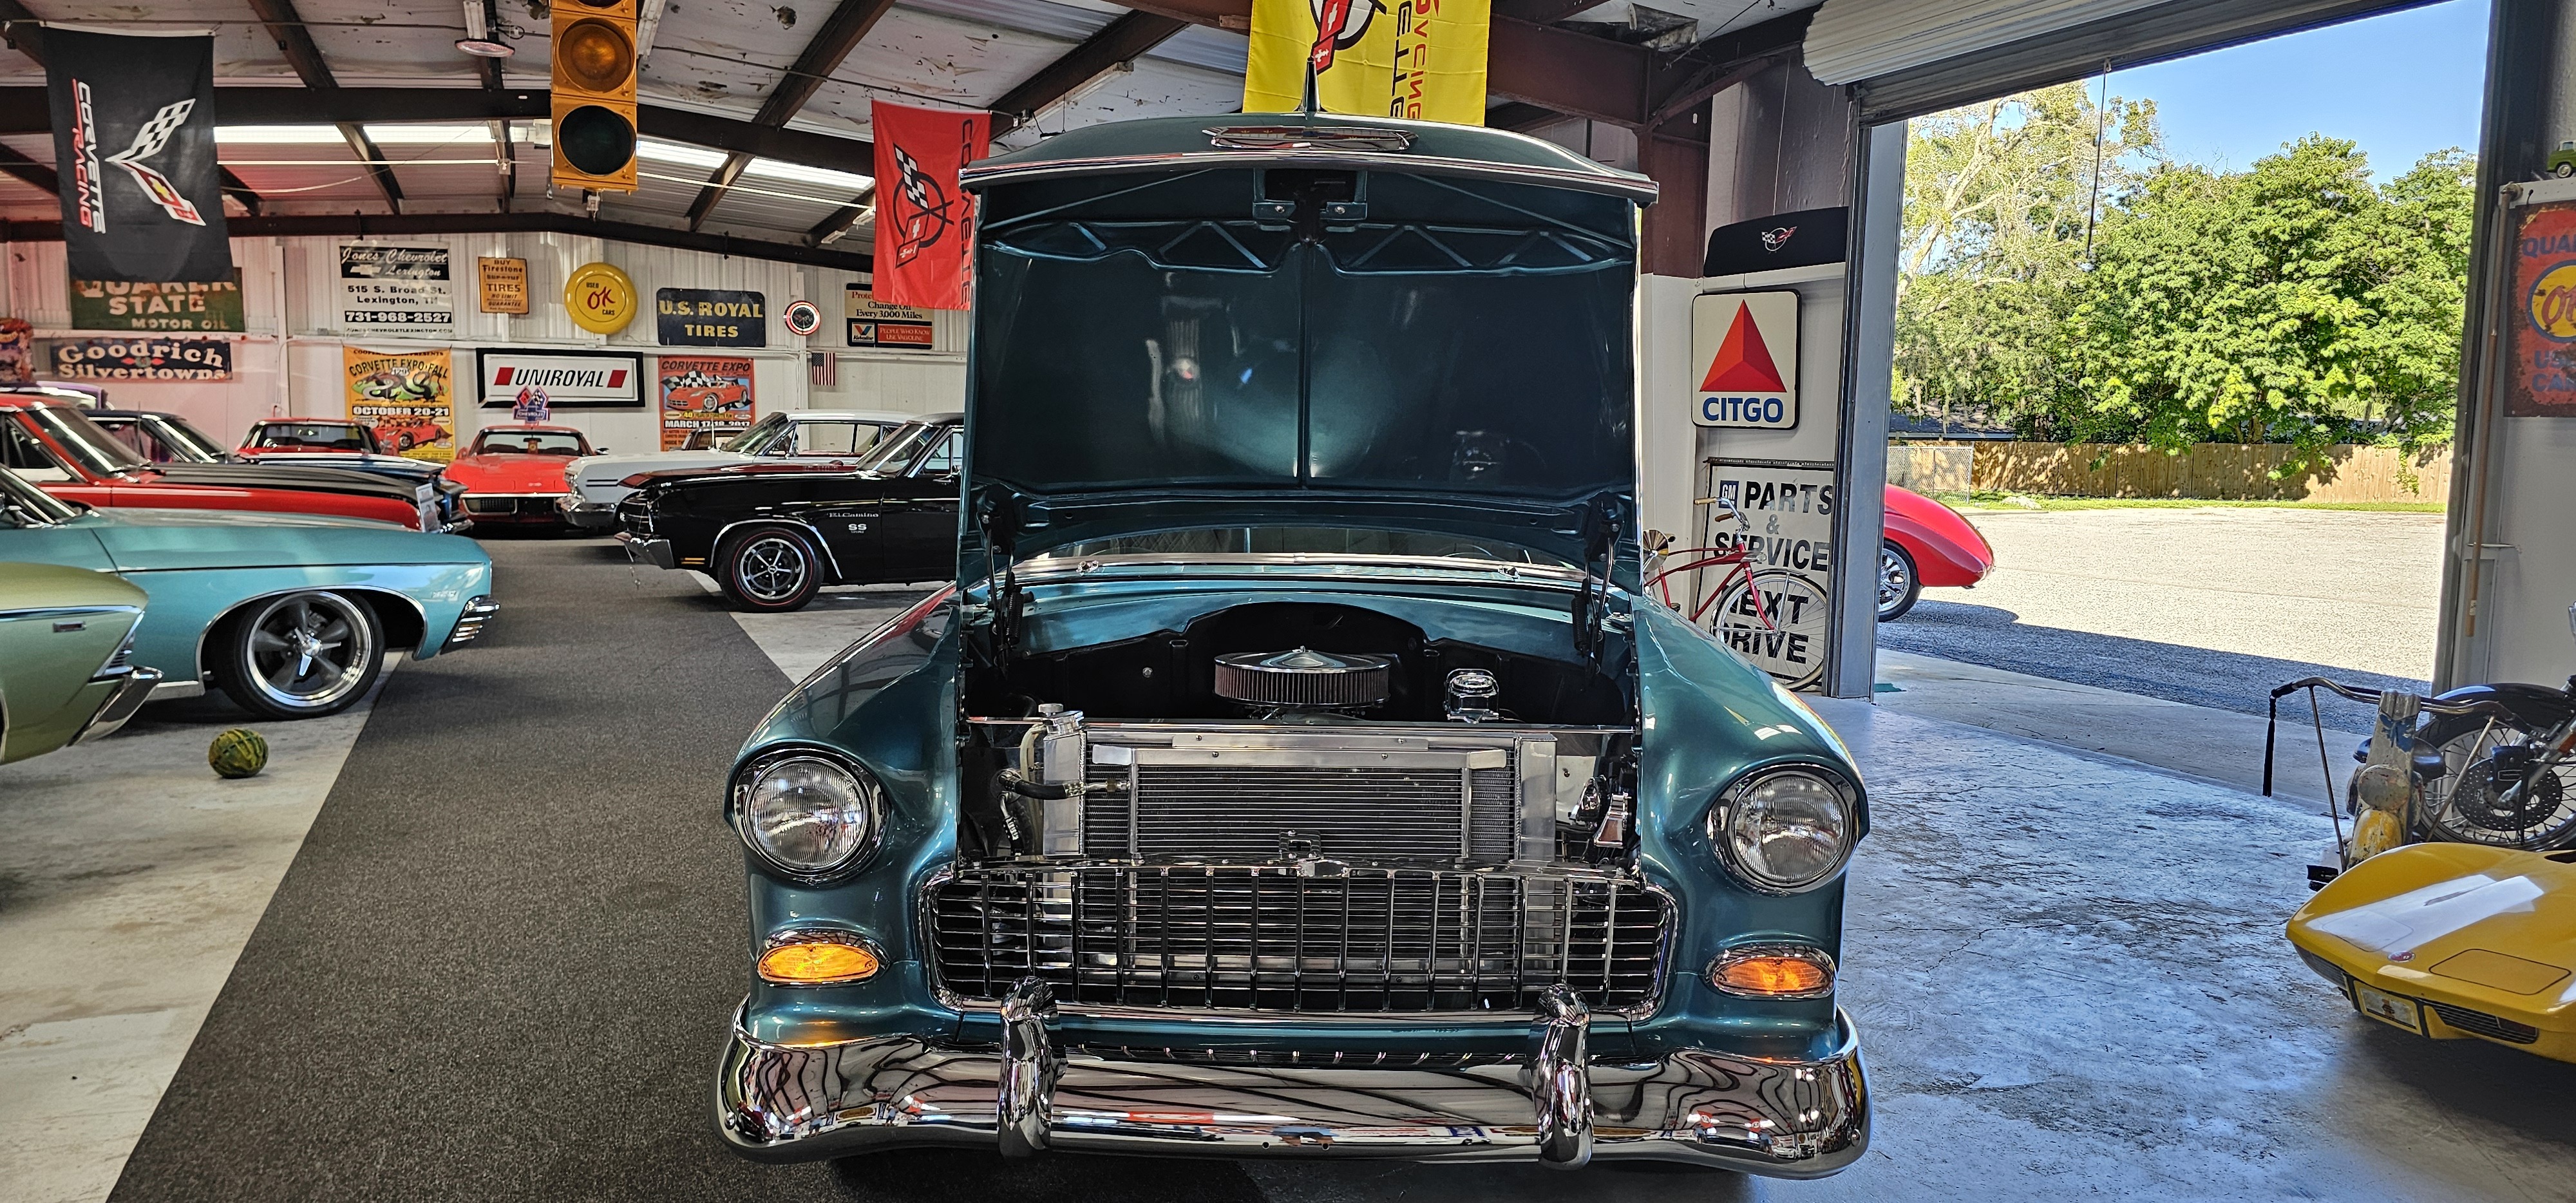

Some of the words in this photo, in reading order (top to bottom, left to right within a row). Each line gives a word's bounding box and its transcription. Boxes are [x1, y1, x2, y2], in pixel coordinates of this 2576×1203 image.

[72, 78, 92, 227] RACING
[78, 81, 106, 234] CORVETTE
[2522, 234, 2576, 258] QUA
[341, 247, 379, 264] Jones
[386, 249, 448, 264] Chevrolet
[385, 265, 441, 279] Lexington
[390, 286, 425, 294] Broad
[430, 287, 446, 295] St.
[486, 283, 521, 292] TIRES
[109, 294, 205, 315] STATE
[357, 296, 419, 305] Lexington,
[587, 286, 616, 309] OK
[867, 301, 898, 310] Change
[659, 300, 694, 316] U.S.
[698, 302, 763, 317] ROYAL
[856, 309, 878, 318] Every
[131, 318, 193, 329] MOTOR
[201, 319, 230, 330] OIL
[346, 312, 450, 323] 731-968-2527
[685, 325, 739, 337] TIRES
[59, 339, 223, 368] Goodrich
[58, 363, 225, 380] Silvertowns
[349, 359, 397, 377] CORVETTE
[428, 363, 448, 379] FALL
[661, 361, 720, 371] CORVETTE
[721, 362, 750, 372] EXPO
[515, 369, 604, 387] UNIROYAL
[353, 406, 412, 415] OCTOBER
[414, 407, 450, 416] 20-21
[1703, 397, 1784, 423] CITGO
[1721, 484, 1737, 500] GM
[1744, 481, 1833, 515] PARTS
[1766, 514, 1780, 535] &
